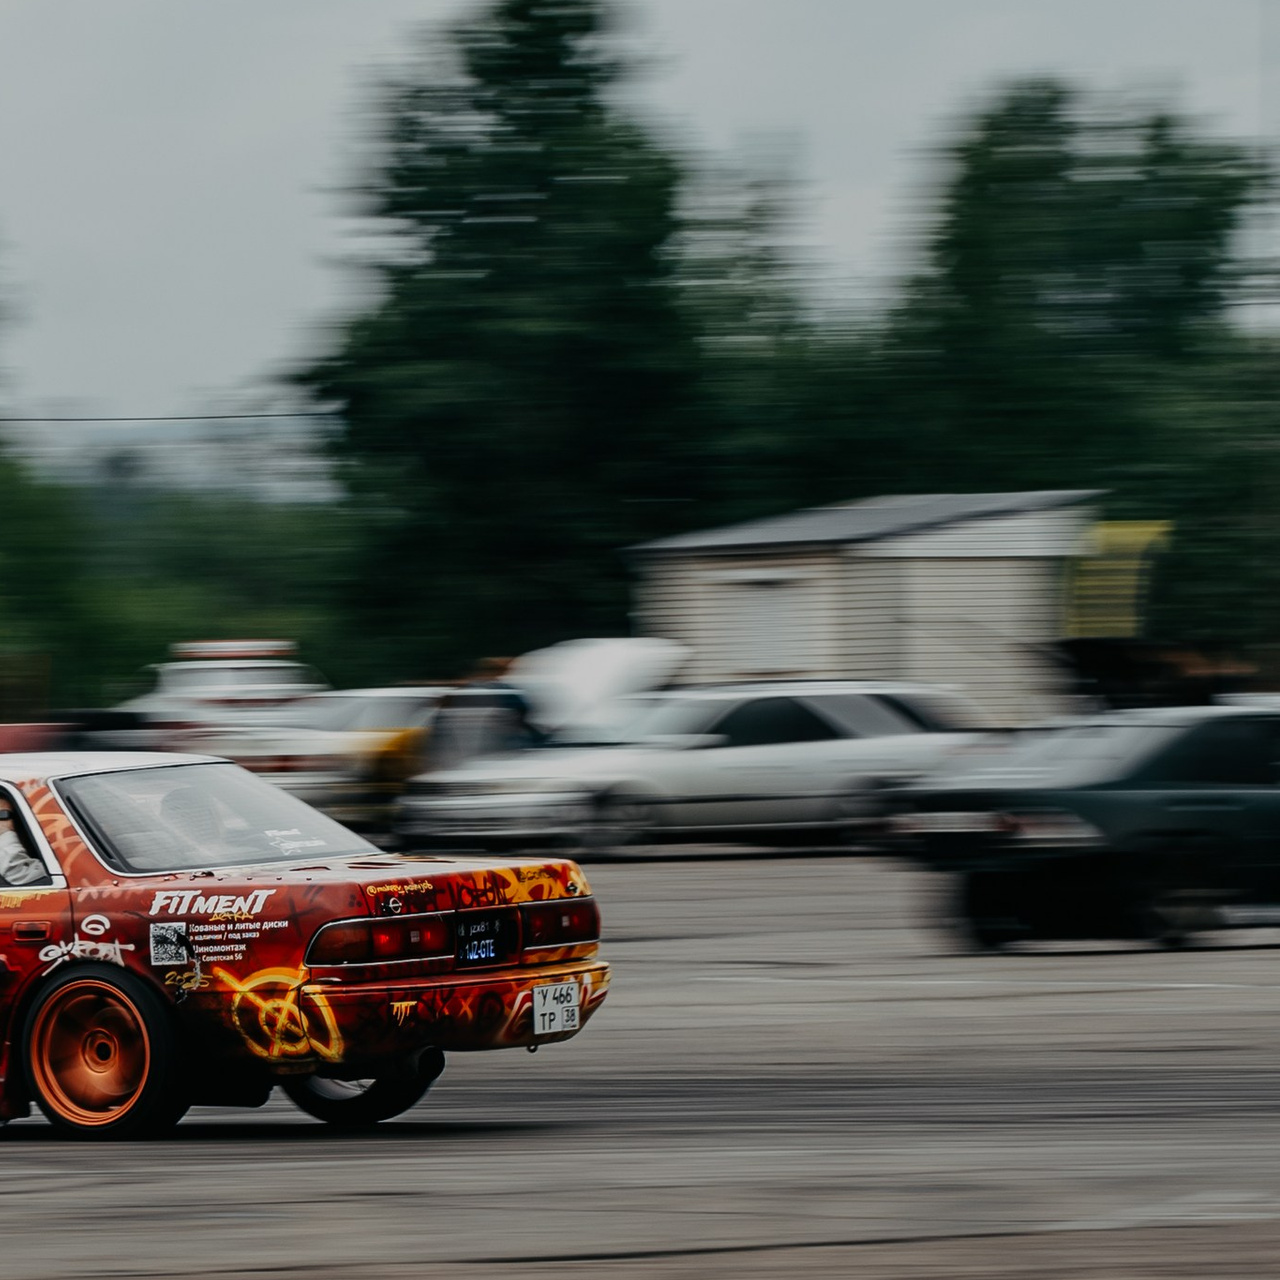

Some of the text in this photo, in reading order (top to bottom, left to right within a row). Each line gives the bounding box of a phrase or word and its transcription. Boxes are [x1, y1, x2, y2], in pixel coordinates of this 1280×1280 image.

[189, 923, 226, 933] Кованые
[235, 921, 261, 930] литые
[262, 920, 289, 931] диски
[202, 954, 234, 962] Советская
[552, 986, 573, 1005] 466
[564, 1008, 576, 1023] 38
